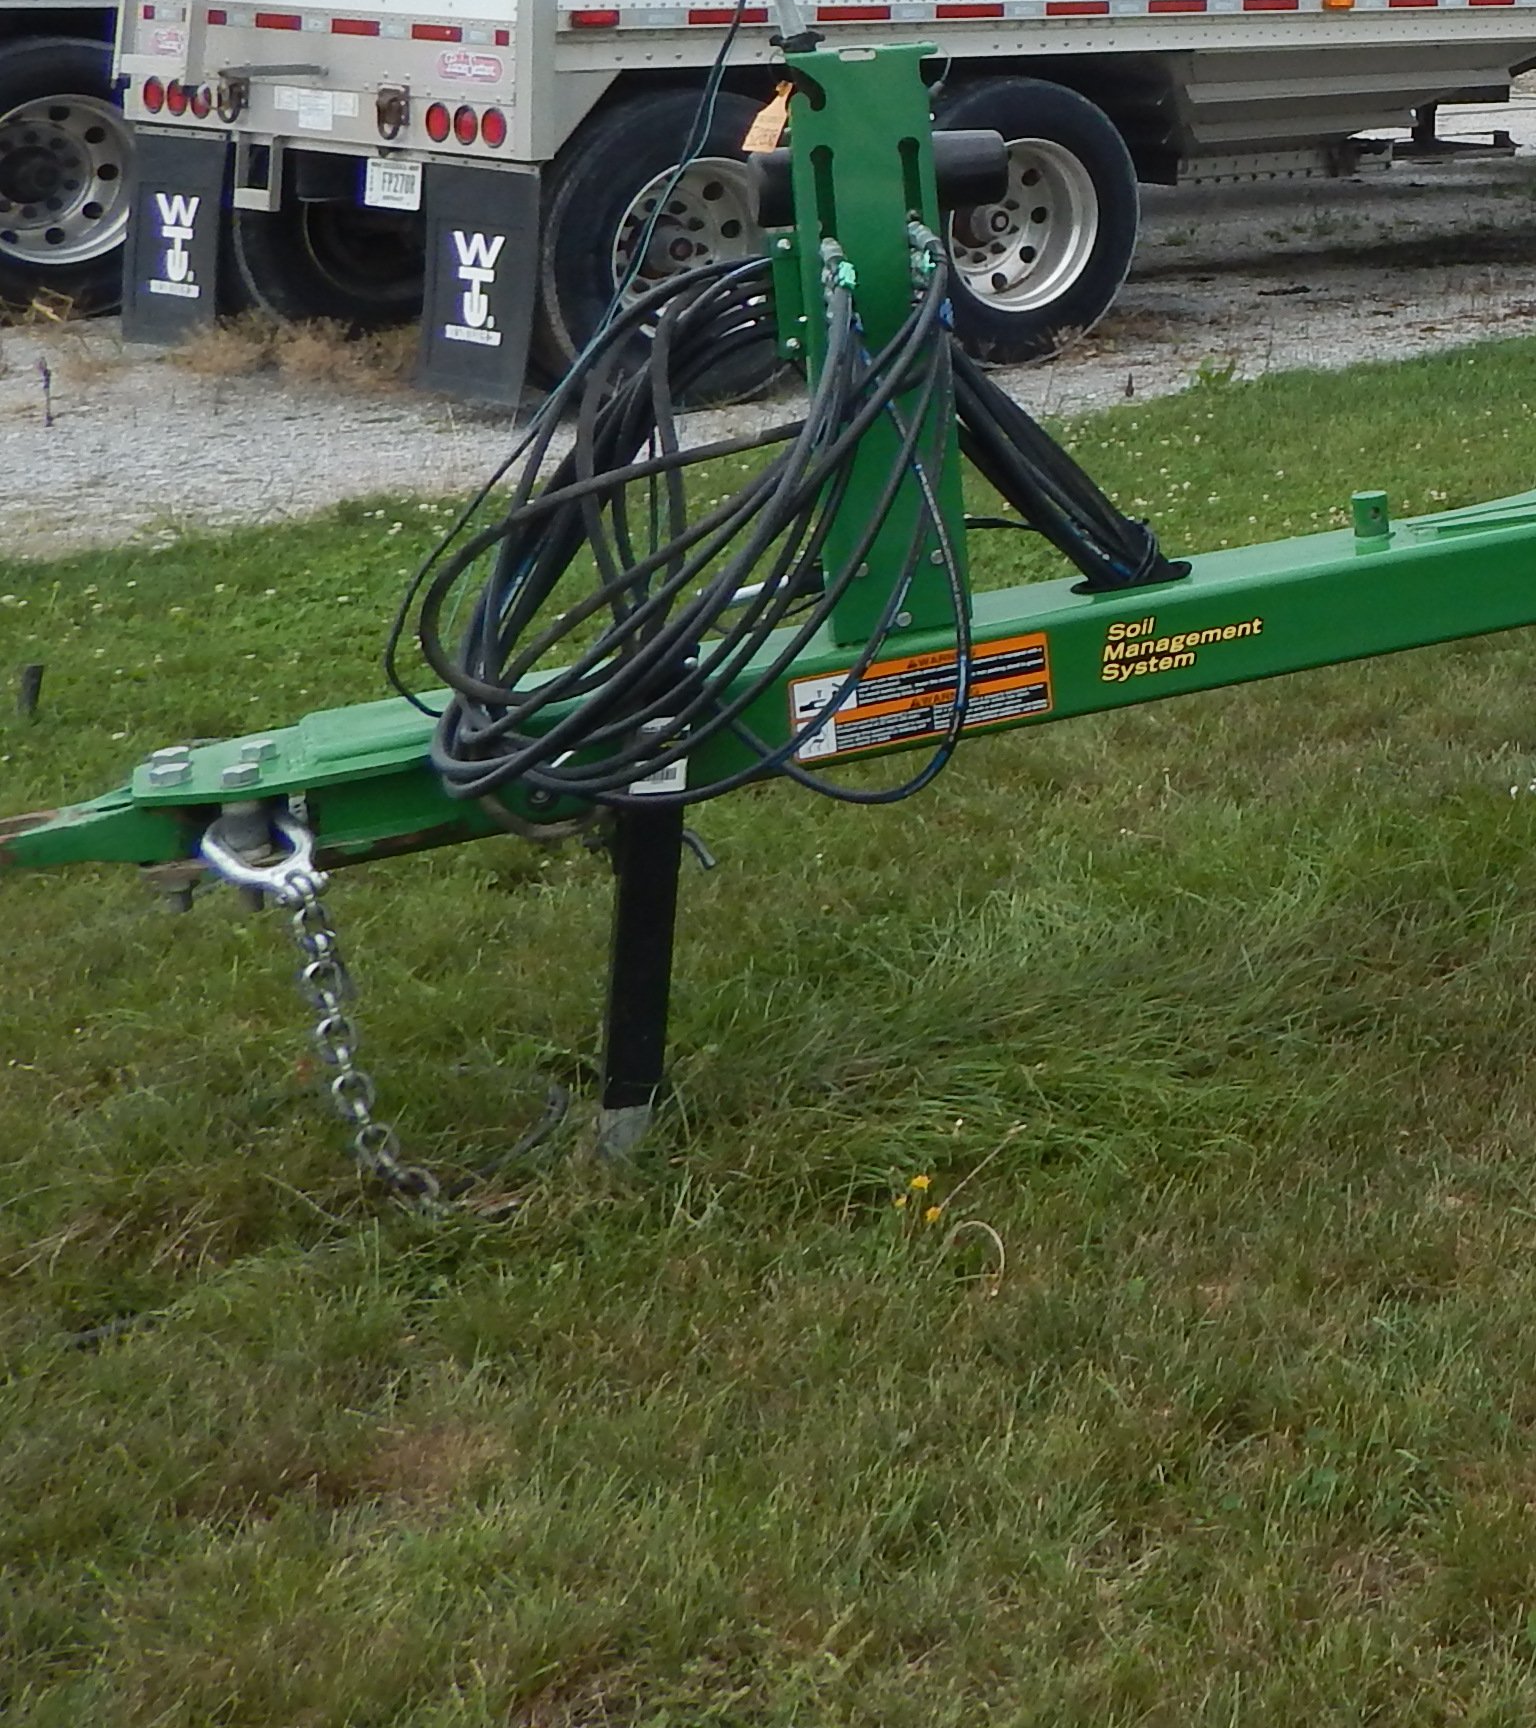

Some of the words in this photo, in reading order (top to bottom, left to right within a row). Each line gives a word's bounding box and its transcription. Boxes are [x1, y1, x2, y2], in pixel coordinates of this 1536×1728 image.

[1103, 618, 1263, 662] Management
[1107, 617, 1155, 641] Soil
[1101, 652, 1195, 682] System
